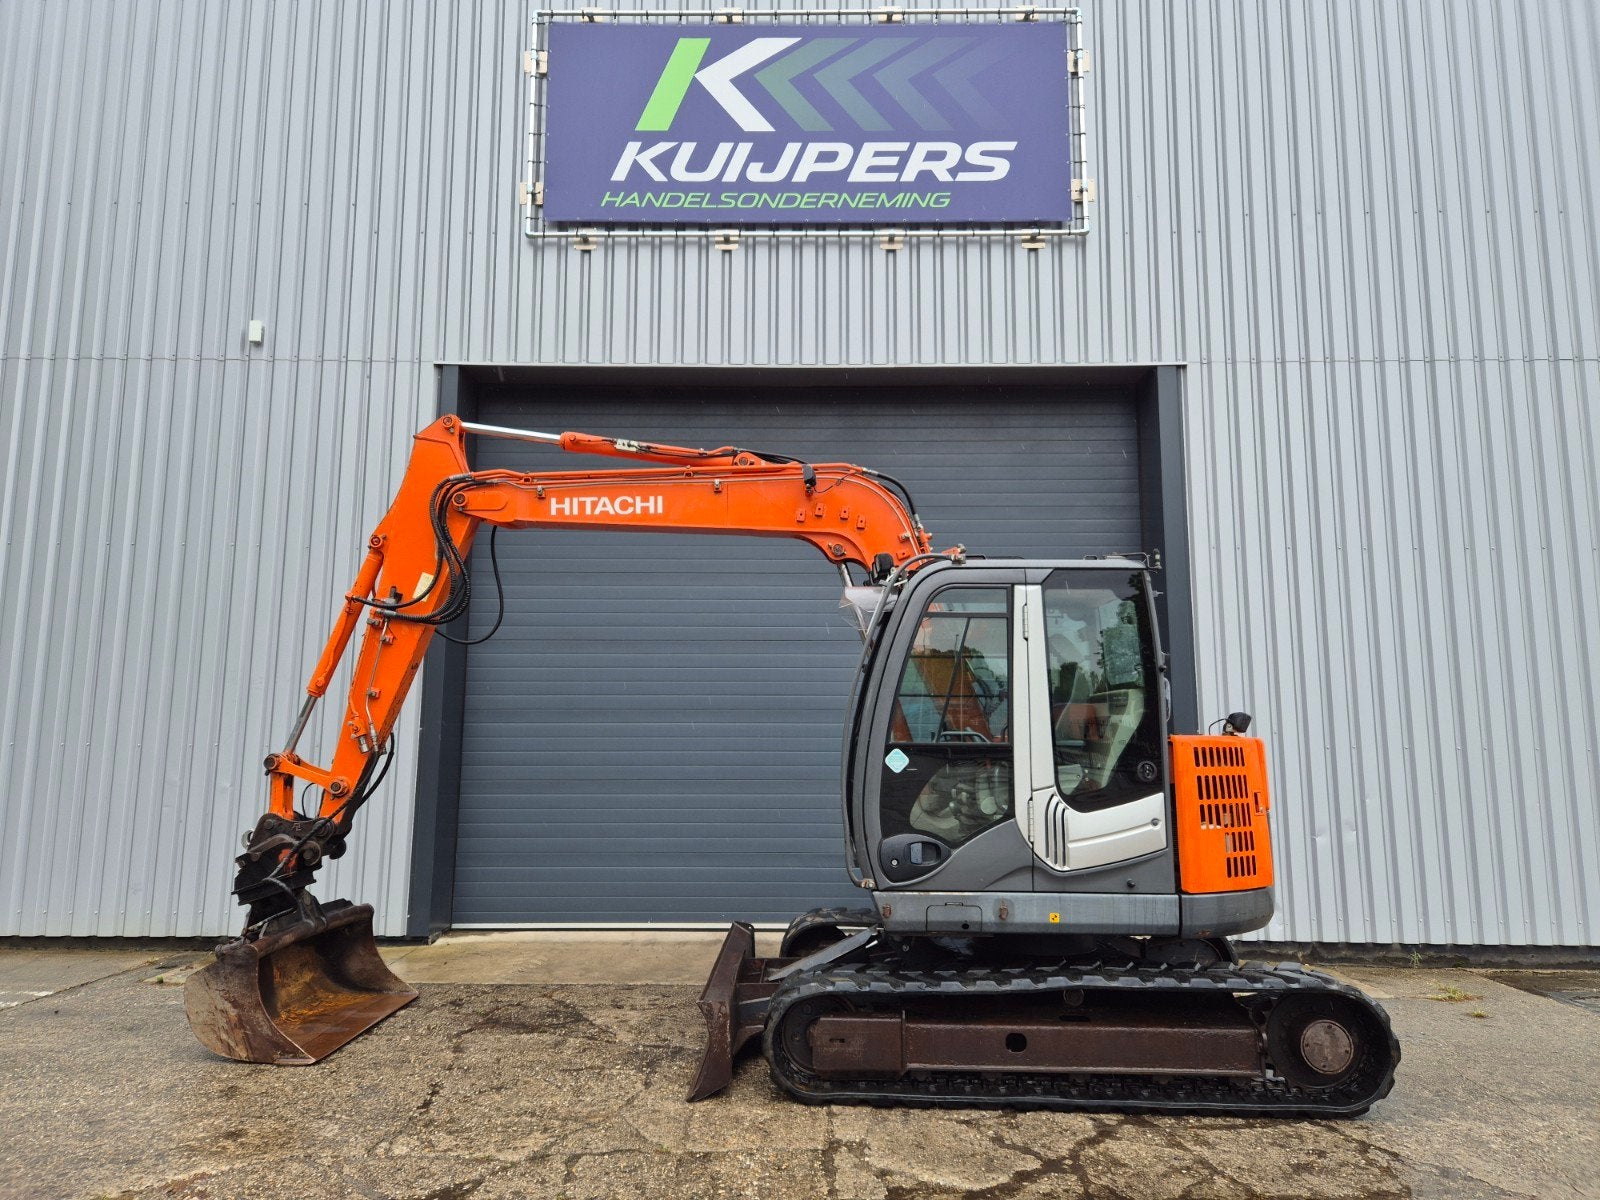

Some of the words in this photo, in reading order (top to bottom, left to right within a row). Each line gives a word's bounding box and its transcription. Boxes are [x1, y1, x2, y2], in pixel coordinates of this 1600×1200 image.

[609, 140, 1019, 183] KUIJPERS
[600, 191, 951, 210] HANDELSONDERNEMING
[550, 495, 664, 516] HITACHI
